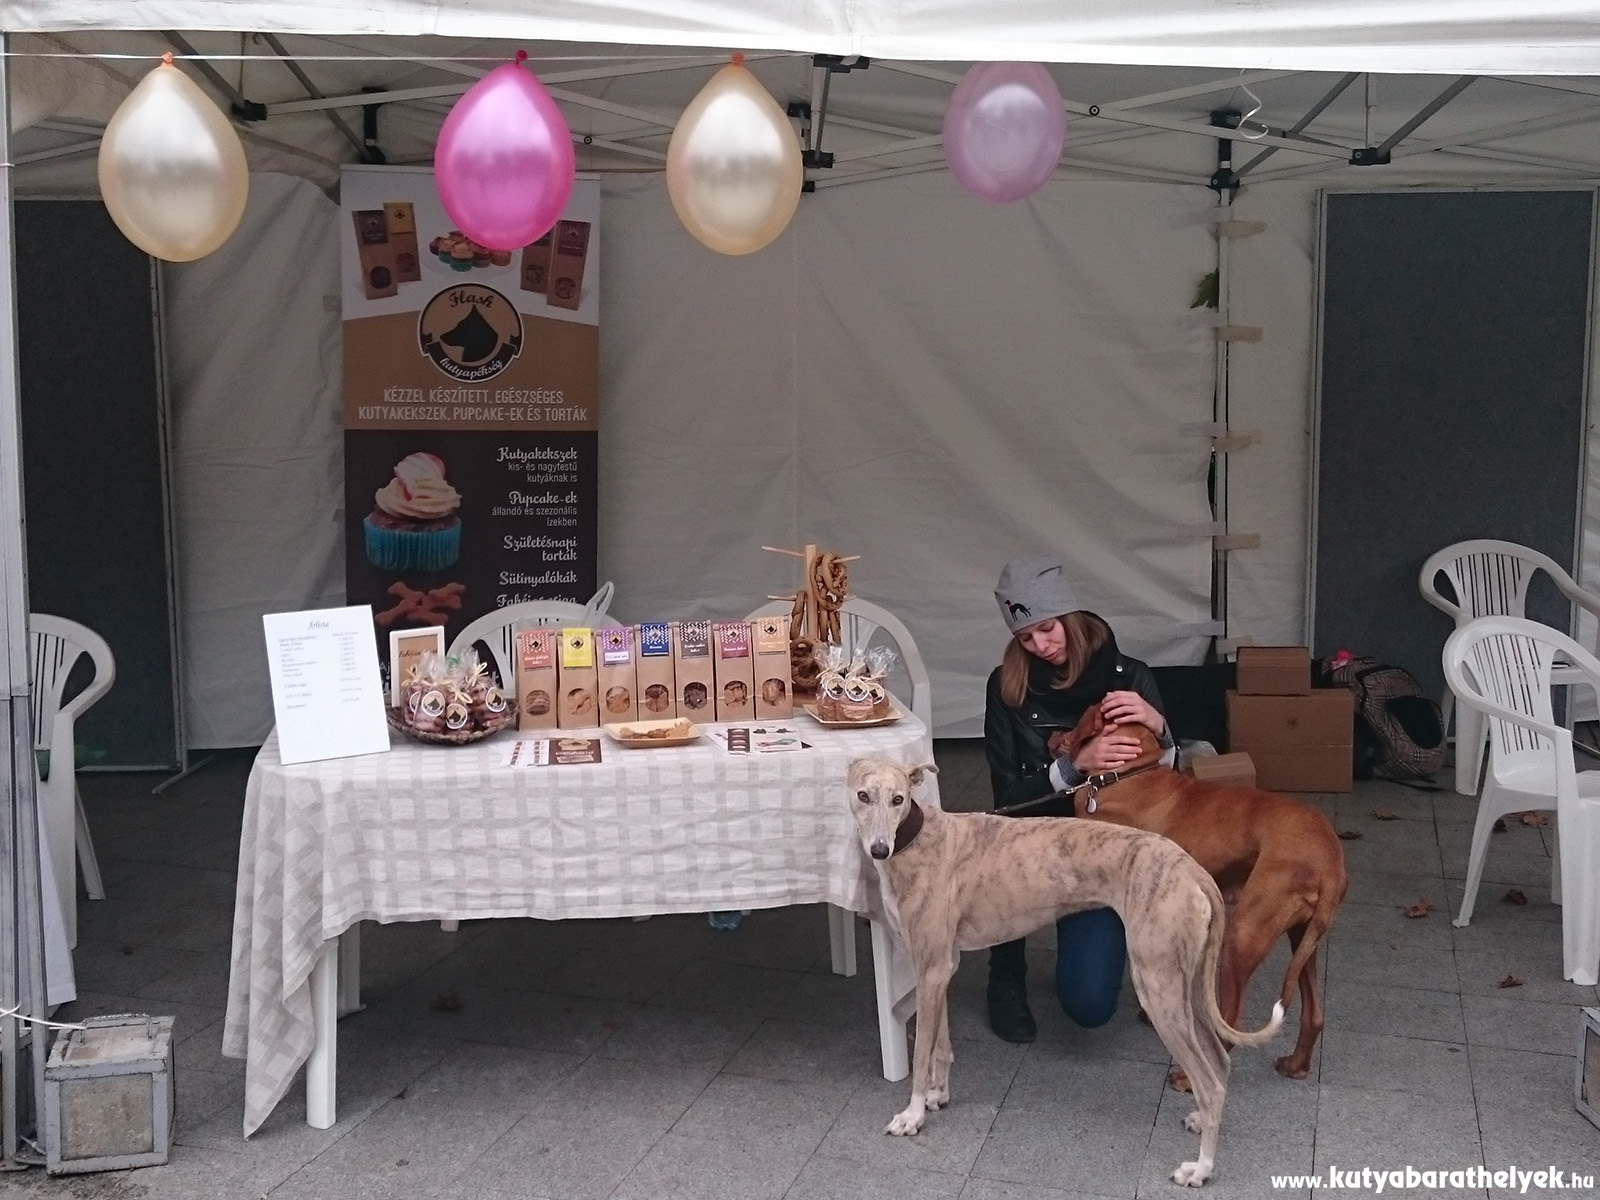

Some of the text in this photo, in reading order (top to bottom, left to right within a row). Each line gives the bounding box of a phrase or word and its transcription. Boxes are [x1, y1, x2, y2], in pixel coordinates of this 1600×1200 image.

[449, 291, 495, 309] Flash
[384, 386, 426, 404] KÉZZEL
[495, 388, 564, 405] EGÉSZSÉGES
[453, 407, 524, 421] PUPCAKE-EK
[527, 405, 541, 421] ÉS
[544, 406, 587, 422] TORTÁK
[496, 447, 578, 463] Kutyakekszek
[508, 461, 524, 472] kis-
[525, 461, 536, 472] és
[526, 473, 578, 484] kutyáknak is
[508, 490, 578, 508] Pupcake-ek
[492, 506, 578, 516] állandó és szezonális
[546, 517, 578, 526] ízekben
[503, 535, 577, 551] Születésnapi
[542, 549, 577, 562] torták
[499, 571, 577, 588] Sütinyalókák
